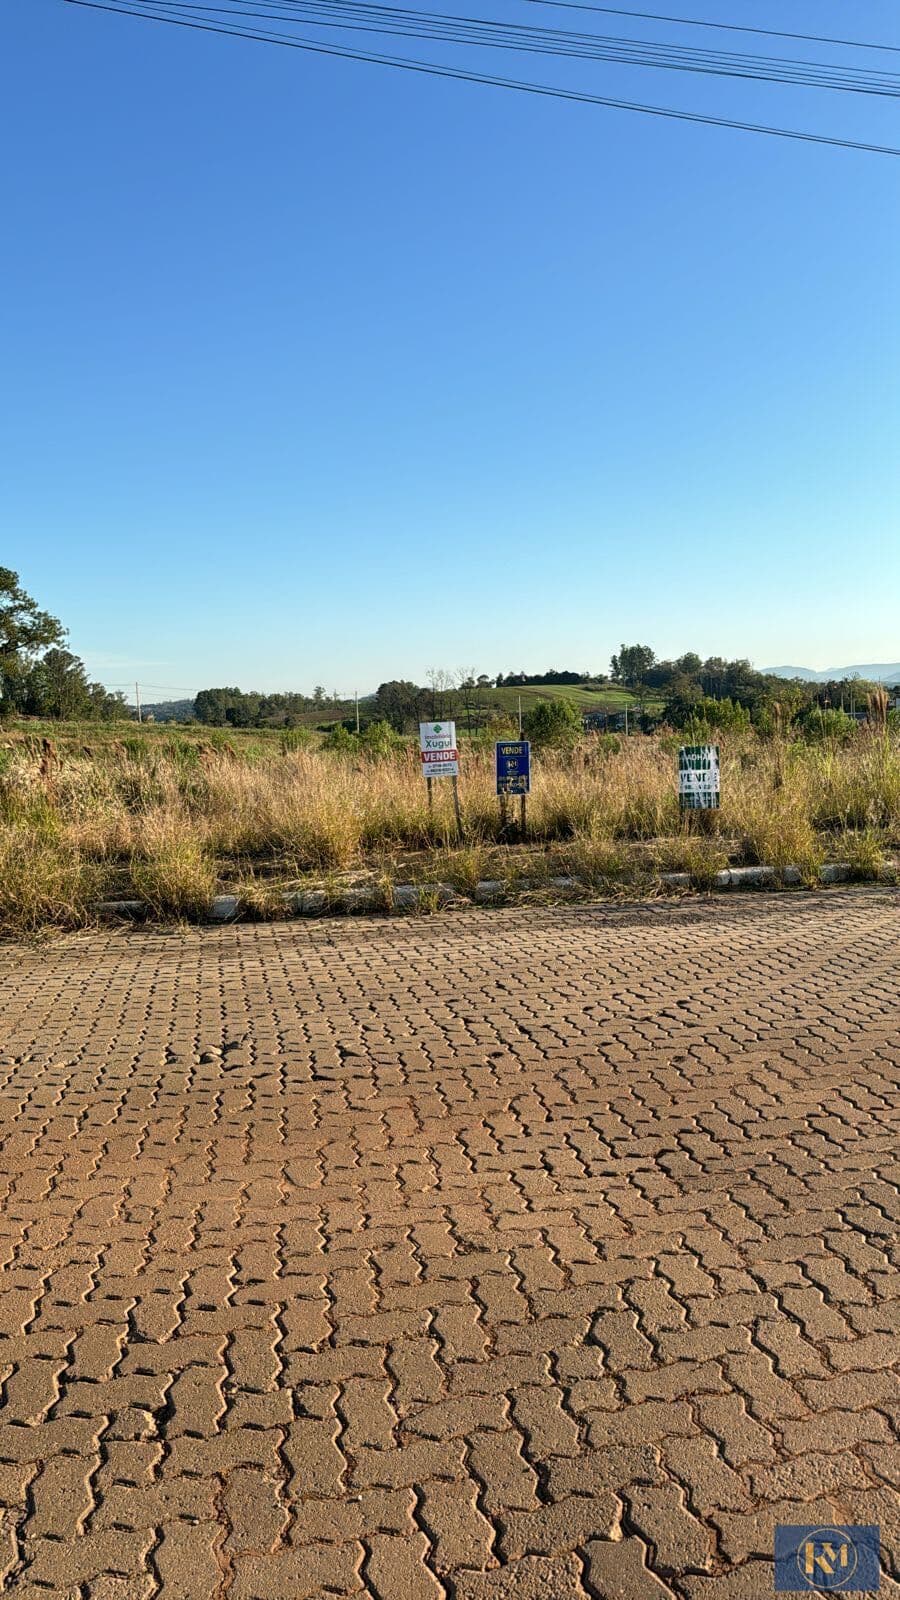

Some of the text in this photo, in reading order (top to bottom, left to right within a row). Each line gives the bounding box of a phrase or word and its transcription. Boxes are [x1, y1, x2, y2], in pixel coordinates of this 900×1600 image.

[425, 739, 452, 749] Xugui
[501, 746, 524, 755] VENDE
[423, 751, 456, 762] VENDE
